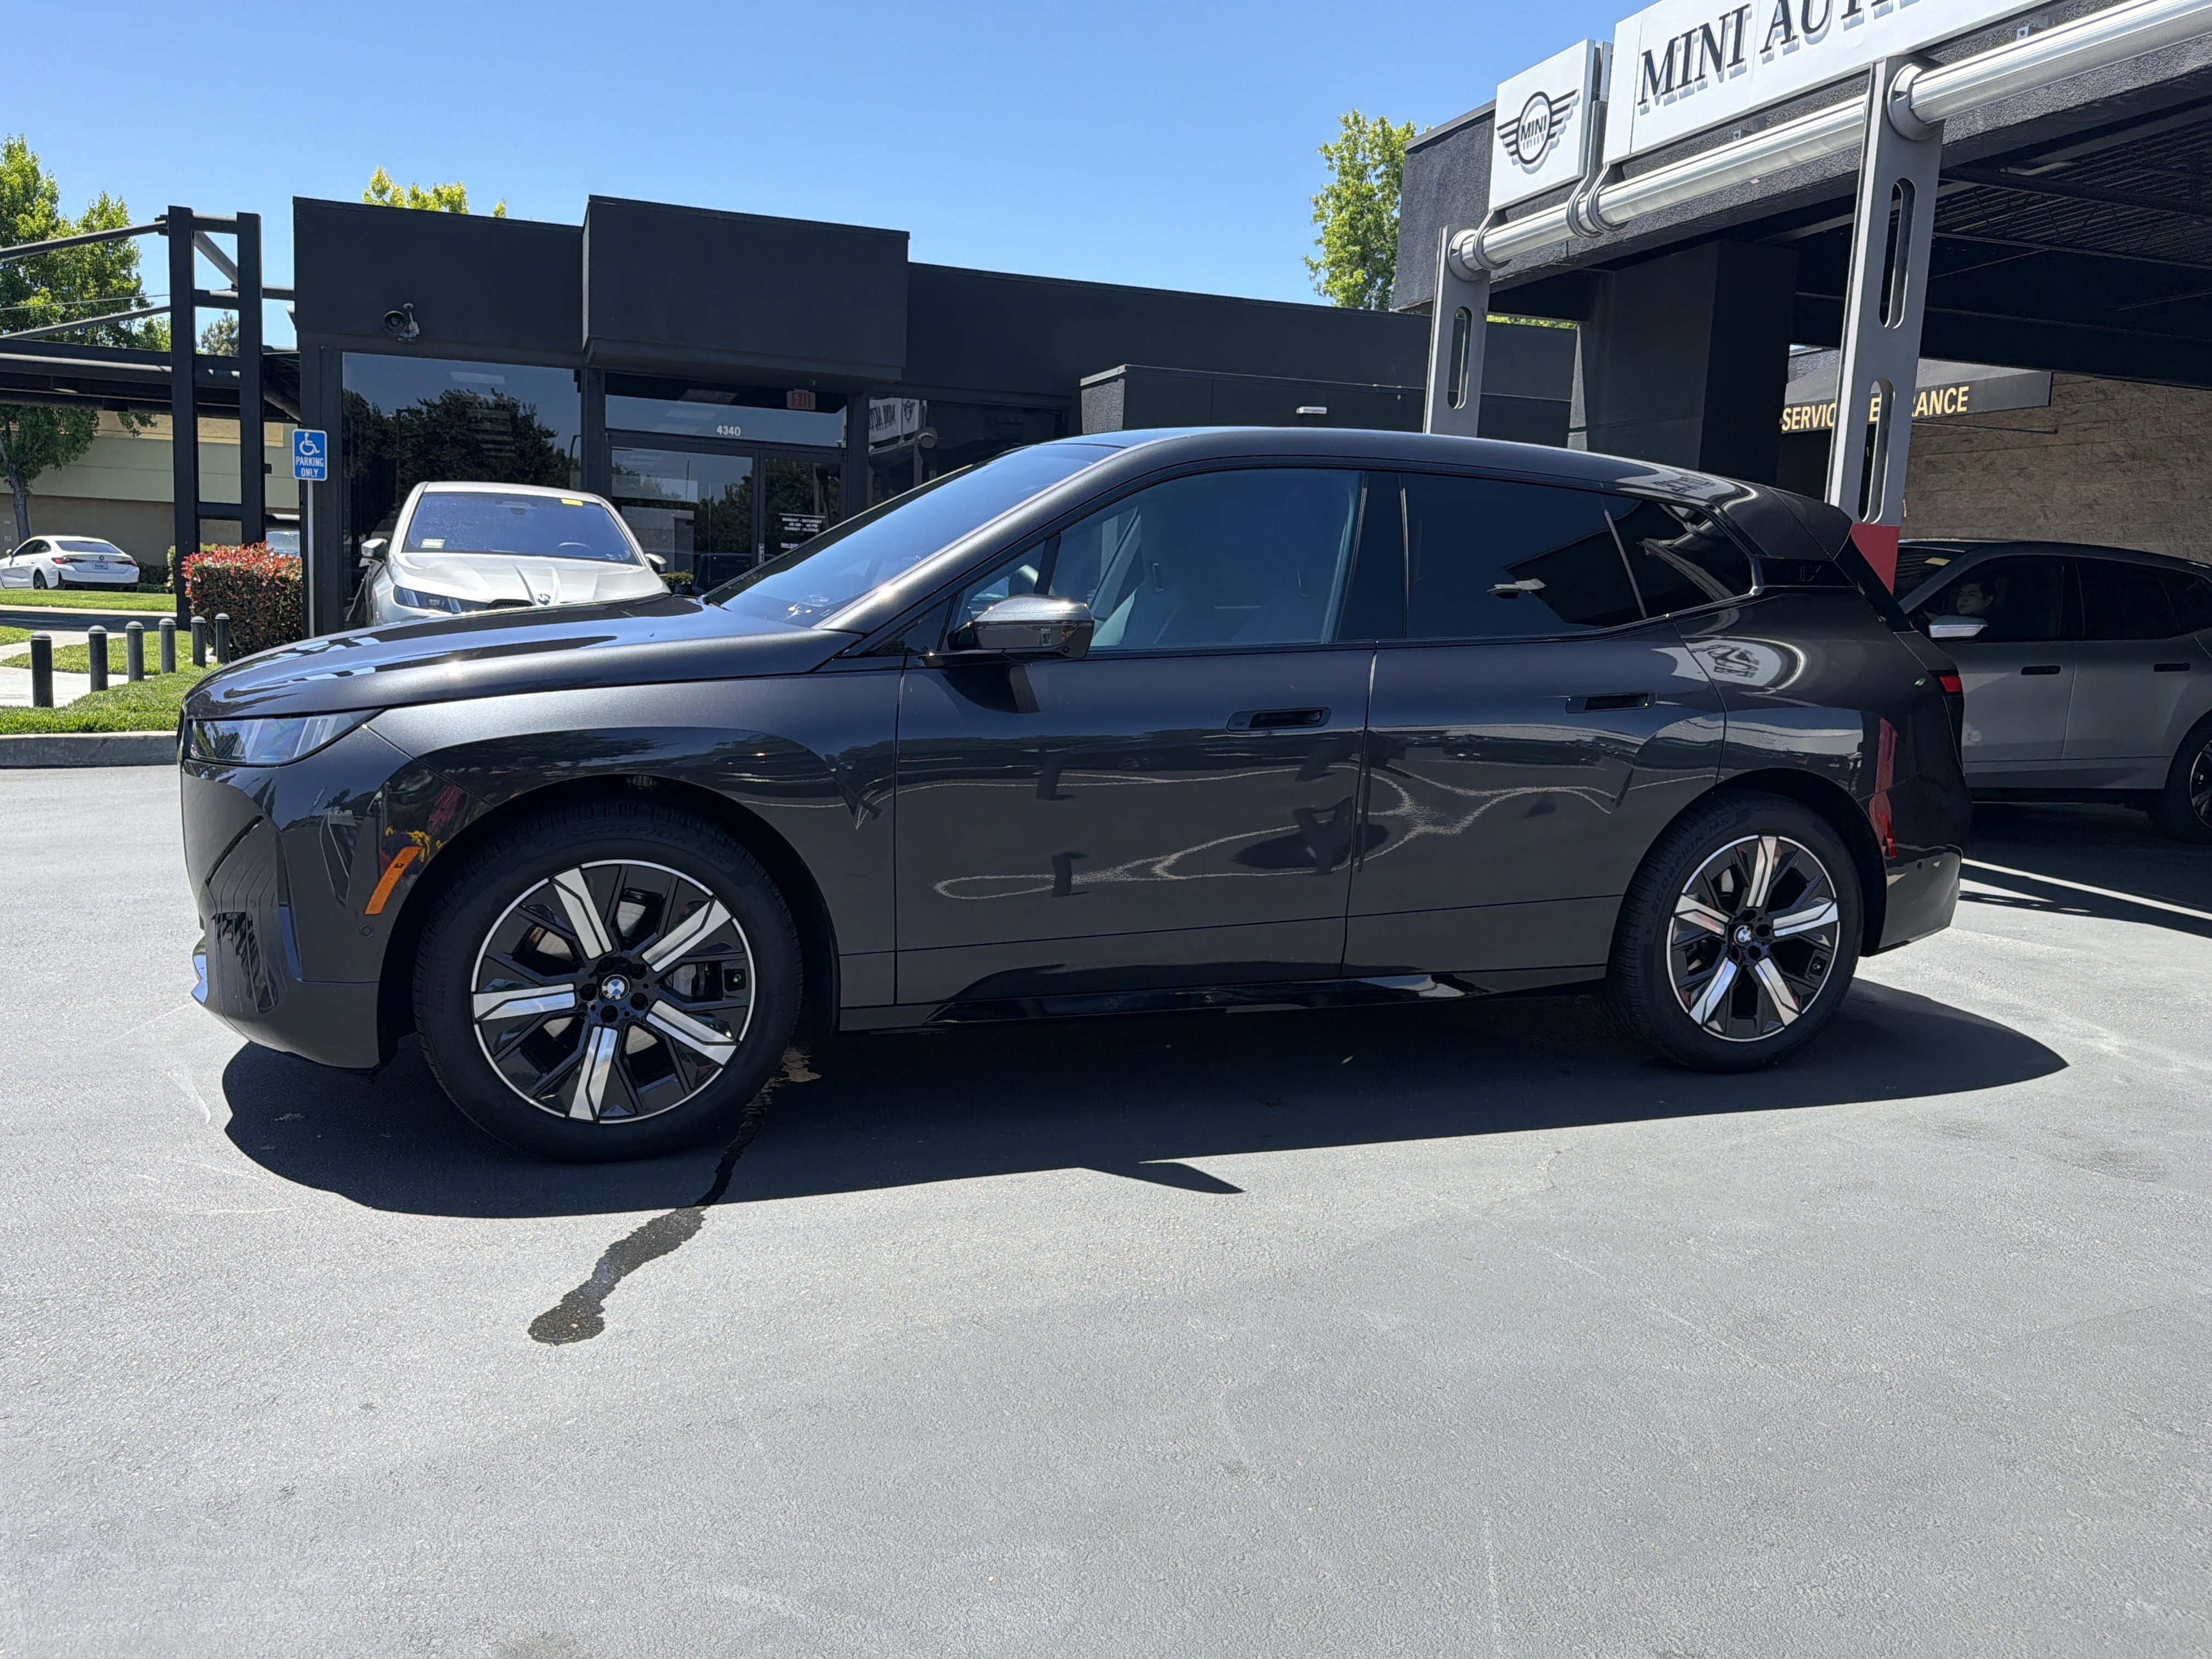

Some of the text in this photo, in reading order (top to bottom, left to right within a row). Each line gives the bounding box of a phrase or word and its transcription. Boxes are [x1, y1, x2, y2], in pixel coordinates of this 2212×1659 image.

[1638, 3, 1752, 106] MINI
[1521, 114, 1547, 142] MINI
[792, 391, 812, 408] EXIT
[1781, 386, 1970, 431] SERVIC EANCE
[716, 425, 741, 436] 4340
[296, 456, 324, 467] PARKING
[301, 467, 319, 477] ONLY
